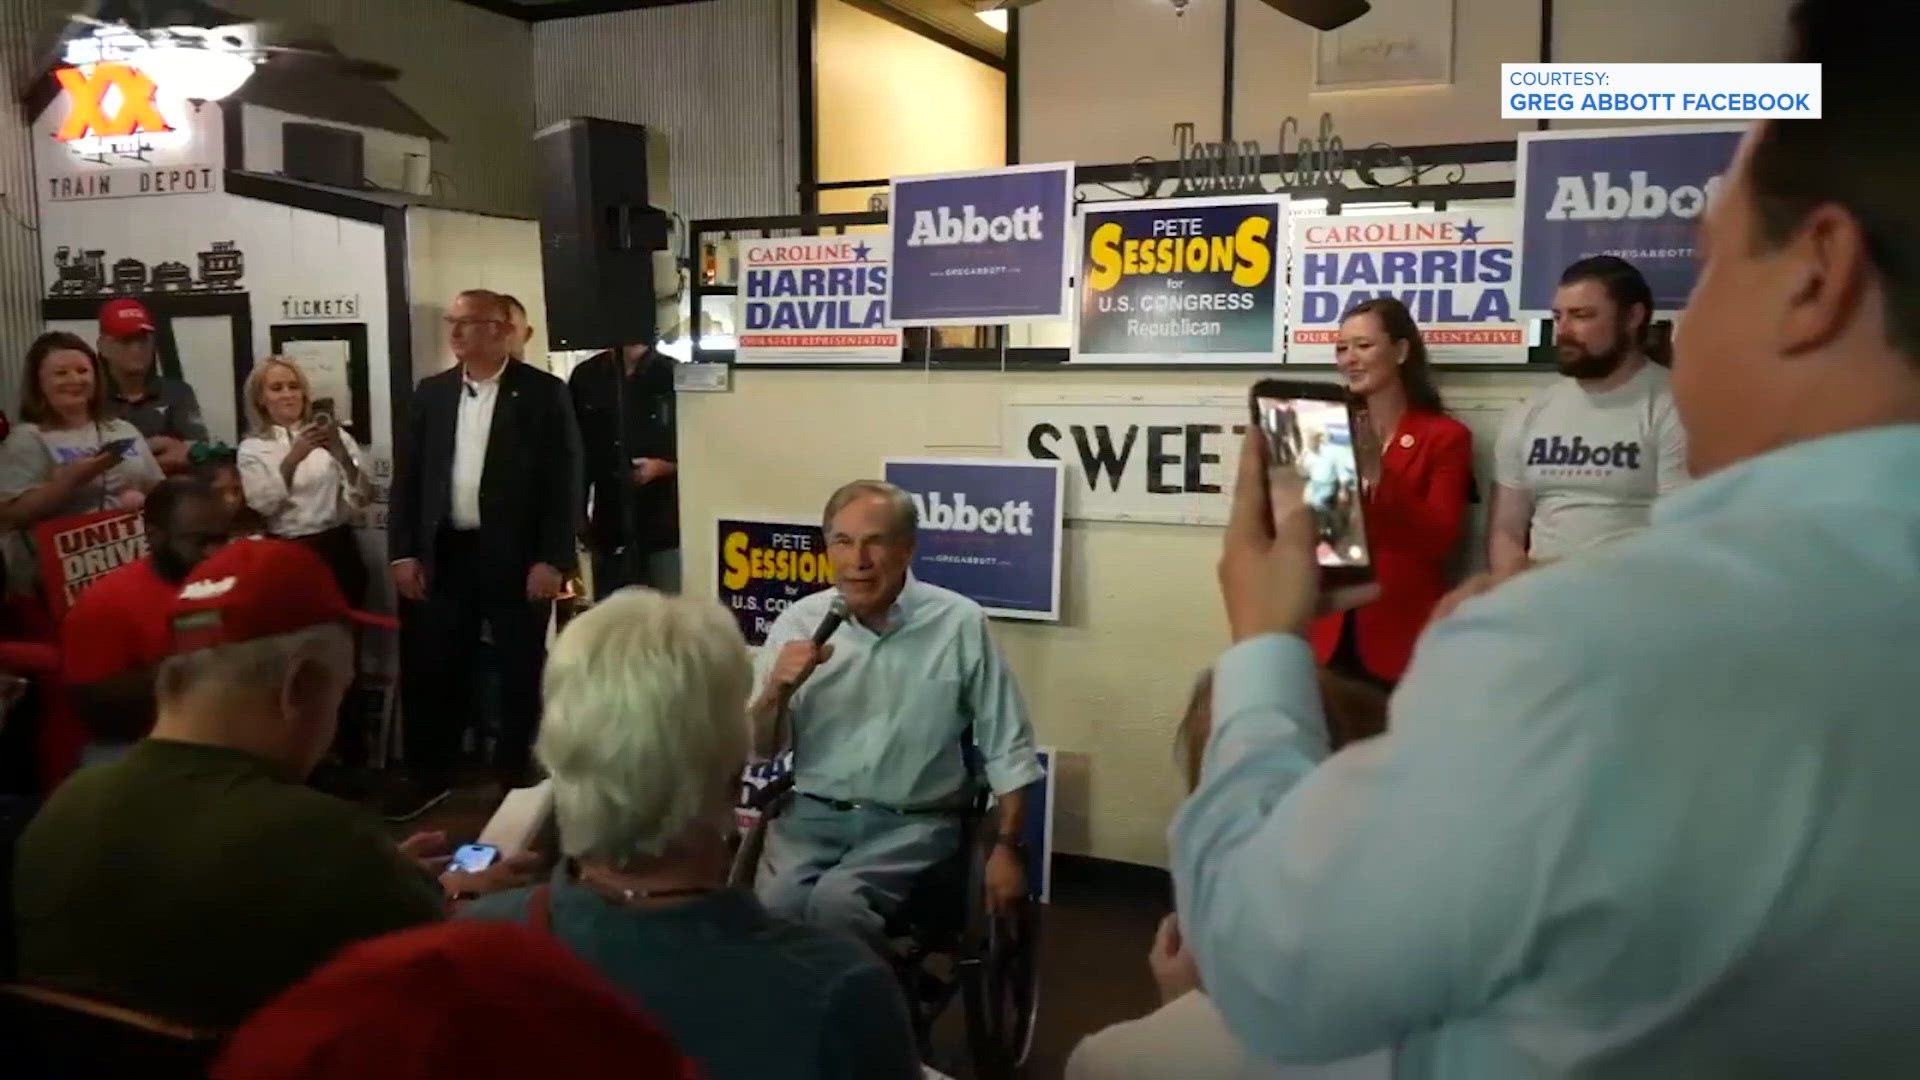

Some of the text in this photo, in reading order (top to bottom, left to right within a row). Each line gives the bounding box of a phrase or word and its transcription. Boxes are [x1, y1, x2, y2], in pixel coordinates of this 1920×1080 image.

[1278, 111, 1344, 187] Cafe
[49, 168, 212, 197] TRAIN DEPOT
[1545, 170, 1728, 222] Abbo
[906, 204, 1044, 247] Abbott
[1152, 217, 1204, 237] PETE
[1304, 222, 1454, 244] CAROLINE
[747, 243, 851, 263] CAROLINE
[1088, 215, 1272, 291] SESSIONS
[1302, 248, 1514, 286] HARRIS
[746, 266, 888, 298] HARRIS
[1166, 278, 1184, 290] for
[281, 298, 355, 316] TICKETS
[744, 301, 887, 330] DAVILA
[1098, 293, 1255, 312] U.S. CONGRESS
[1126, 318, 1221, 338] Republican
[1296, 332, 1330, 343] OUR
[1422, 331, 1520, 343] ESENTATIVE
[1026, 422, 1247, 494] SWEE
[1526, 435, 1641, 470] Abbott
[59, 512, 146, 554] UNIT
[771, 532, 812, 551] PETE
[722, 531, 834, 591] SESSION
[731, 595, 760, 610] U.S.
